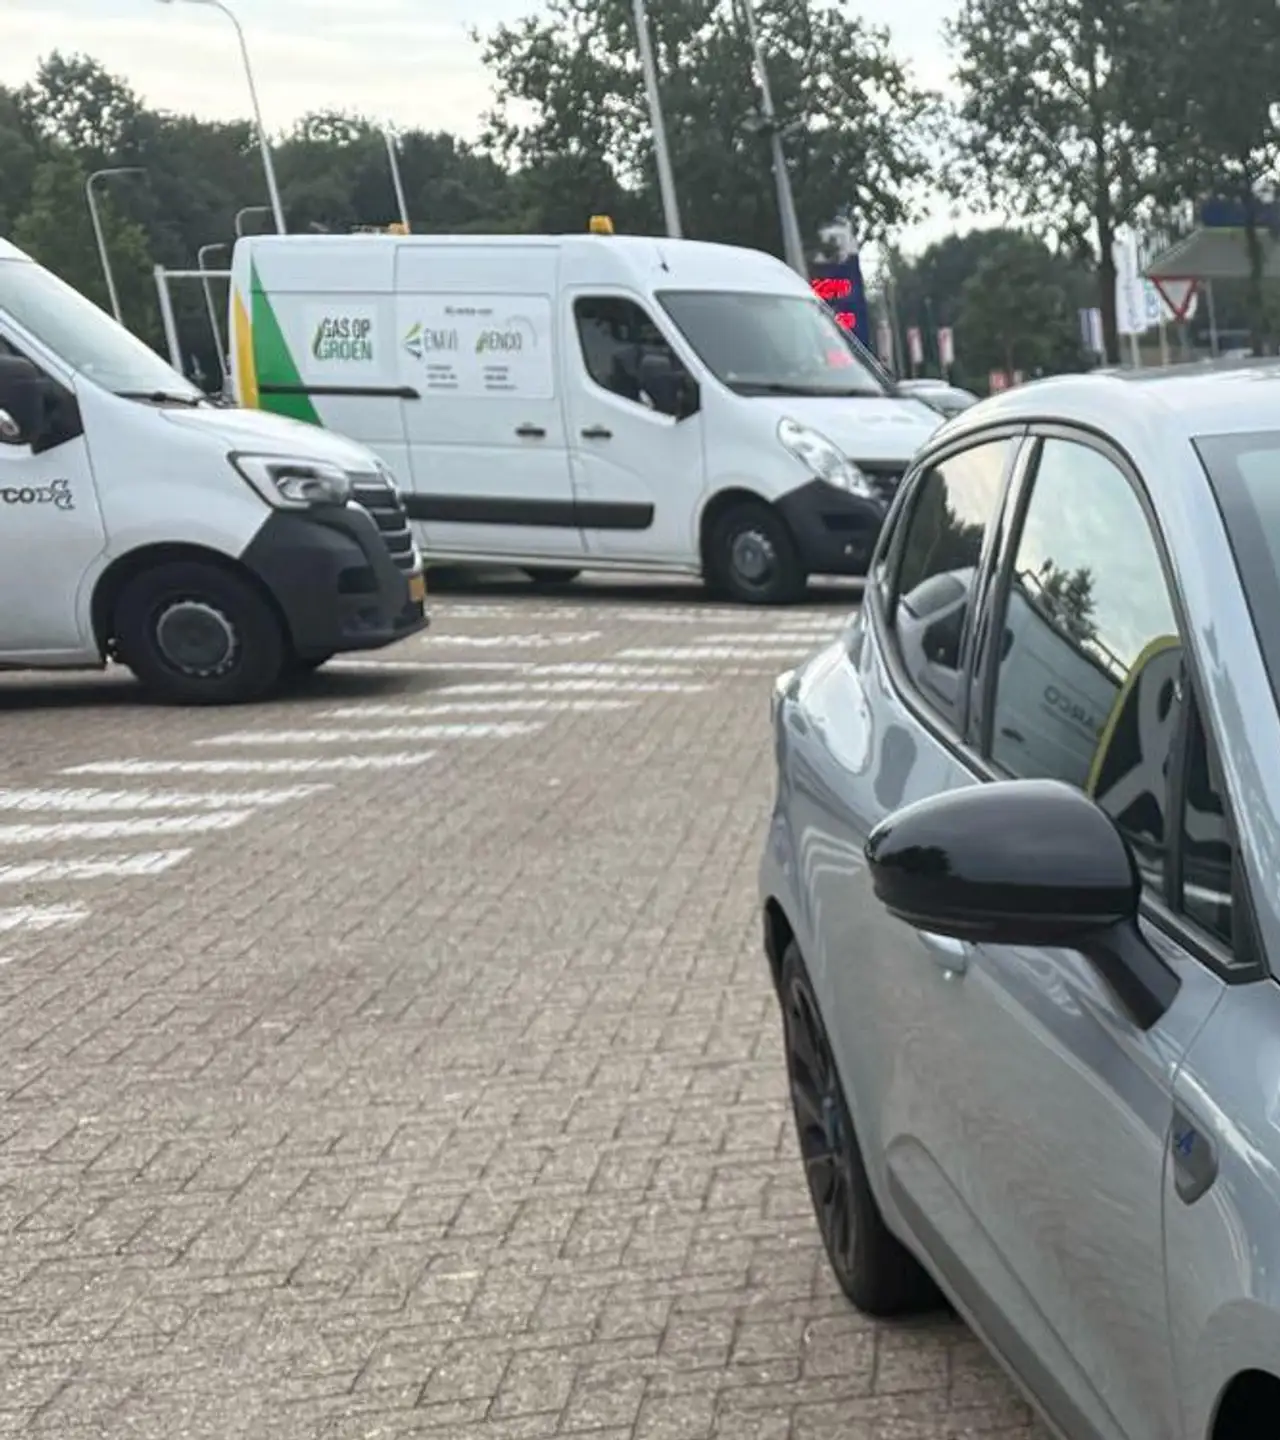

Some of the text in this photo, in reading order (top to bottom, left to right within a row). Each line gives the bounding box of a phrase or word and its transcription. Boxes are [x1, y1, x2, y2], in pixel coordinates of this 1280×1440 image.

[322, 317, 371, 339] GAS OP
[318, 339, 373, 361] GROEN
